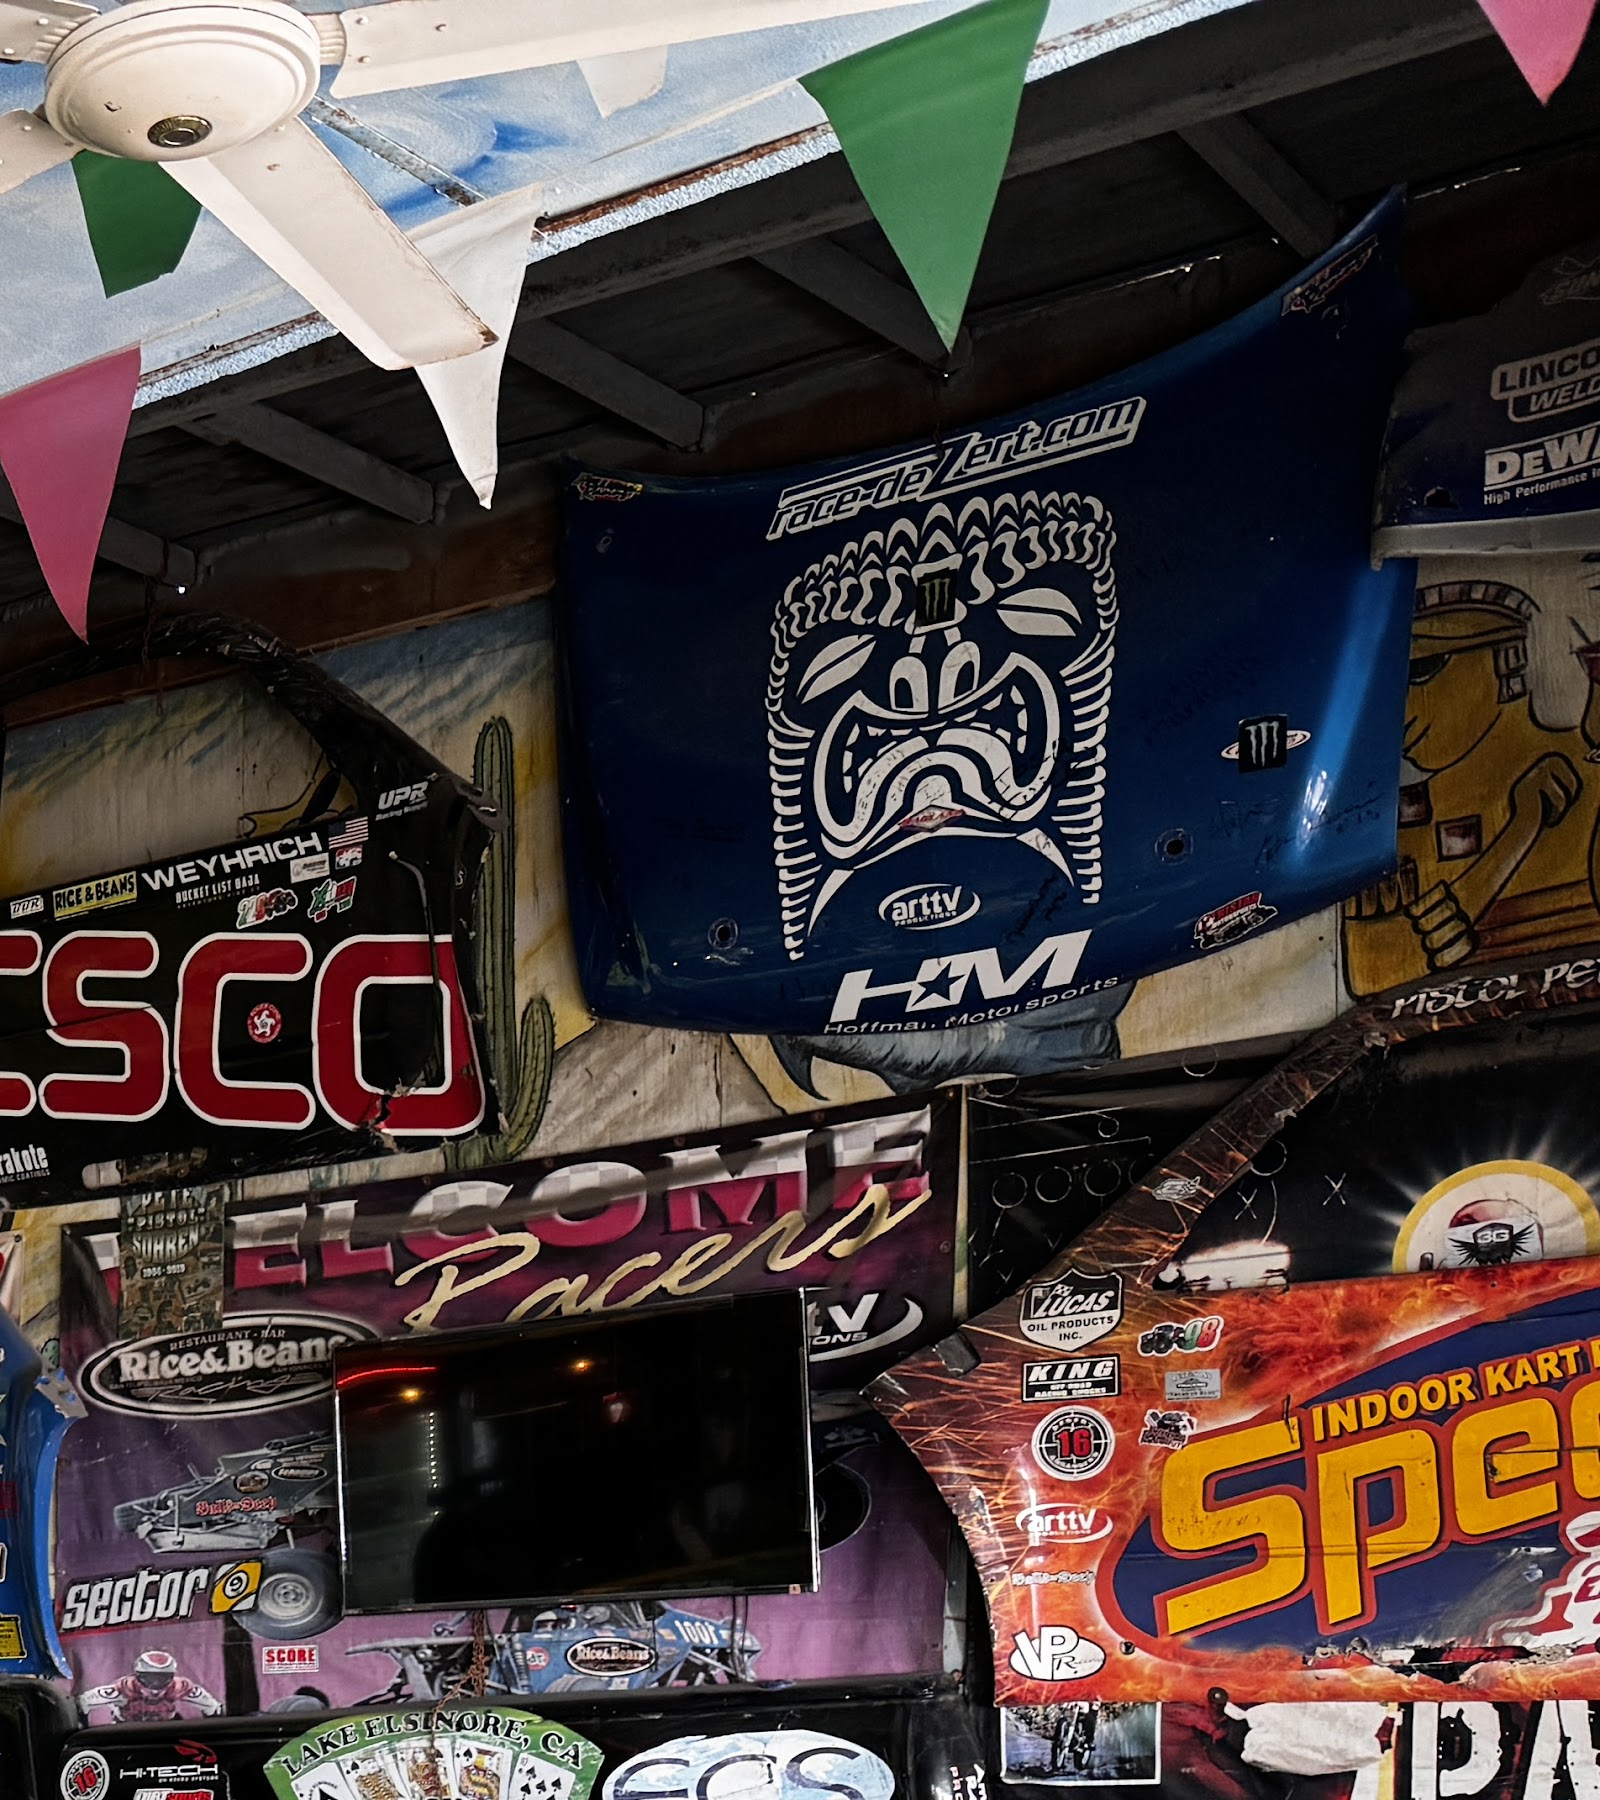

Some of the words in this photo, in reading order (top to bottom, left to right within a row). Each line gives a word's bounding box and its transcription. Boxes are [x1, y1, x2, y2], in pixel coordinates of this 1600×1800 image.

[377, 781, 428, 810] UPR
[142, 832, 322, 890] WEYHRICH
[56, 890, 82, 911] RICE
[96, 876, 135, 900] BEANS
[1033, 1290, 1115, 1319] LUCAS
[1027, 1322, 1047, 1332] OIL
[1051, 1316, 1114, 1330] PRODUCTS
[1059, 1332, 1083, 1341] INC.
[170, 1330, 250, 1351] RESTAURANT
[1028, 1361, 1114, 1382] KING
[1313, 1373, 1475, 1442] INDOOR
[1485, 1346, 1580, 1396] KART
[1057, 1428, 1091, 1458] 16
[62, 1567, 212, 1631] sector
[265, 1648, 316, 1664] SCORE
[282, 1724, 359, 1779] LAKE
[540, 1731, 583, 1769] CA
[73, 1766, 98, 1795] 16
